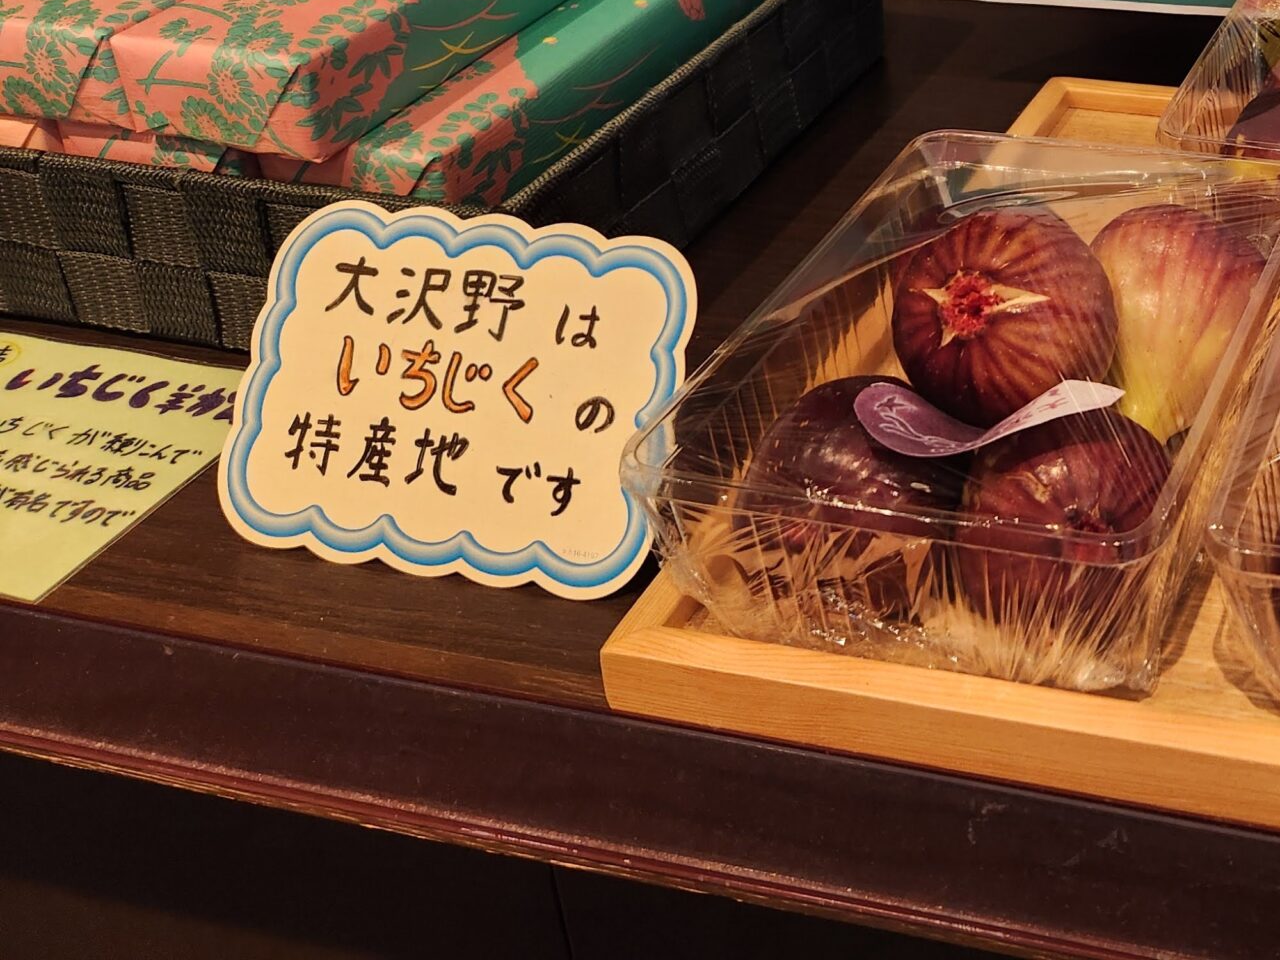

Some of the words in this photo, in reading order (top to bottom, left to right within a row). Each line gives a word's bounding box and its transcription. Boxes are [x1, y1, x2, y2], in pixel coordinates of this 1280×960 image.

[284, 412, 582, 517] 特産地です
